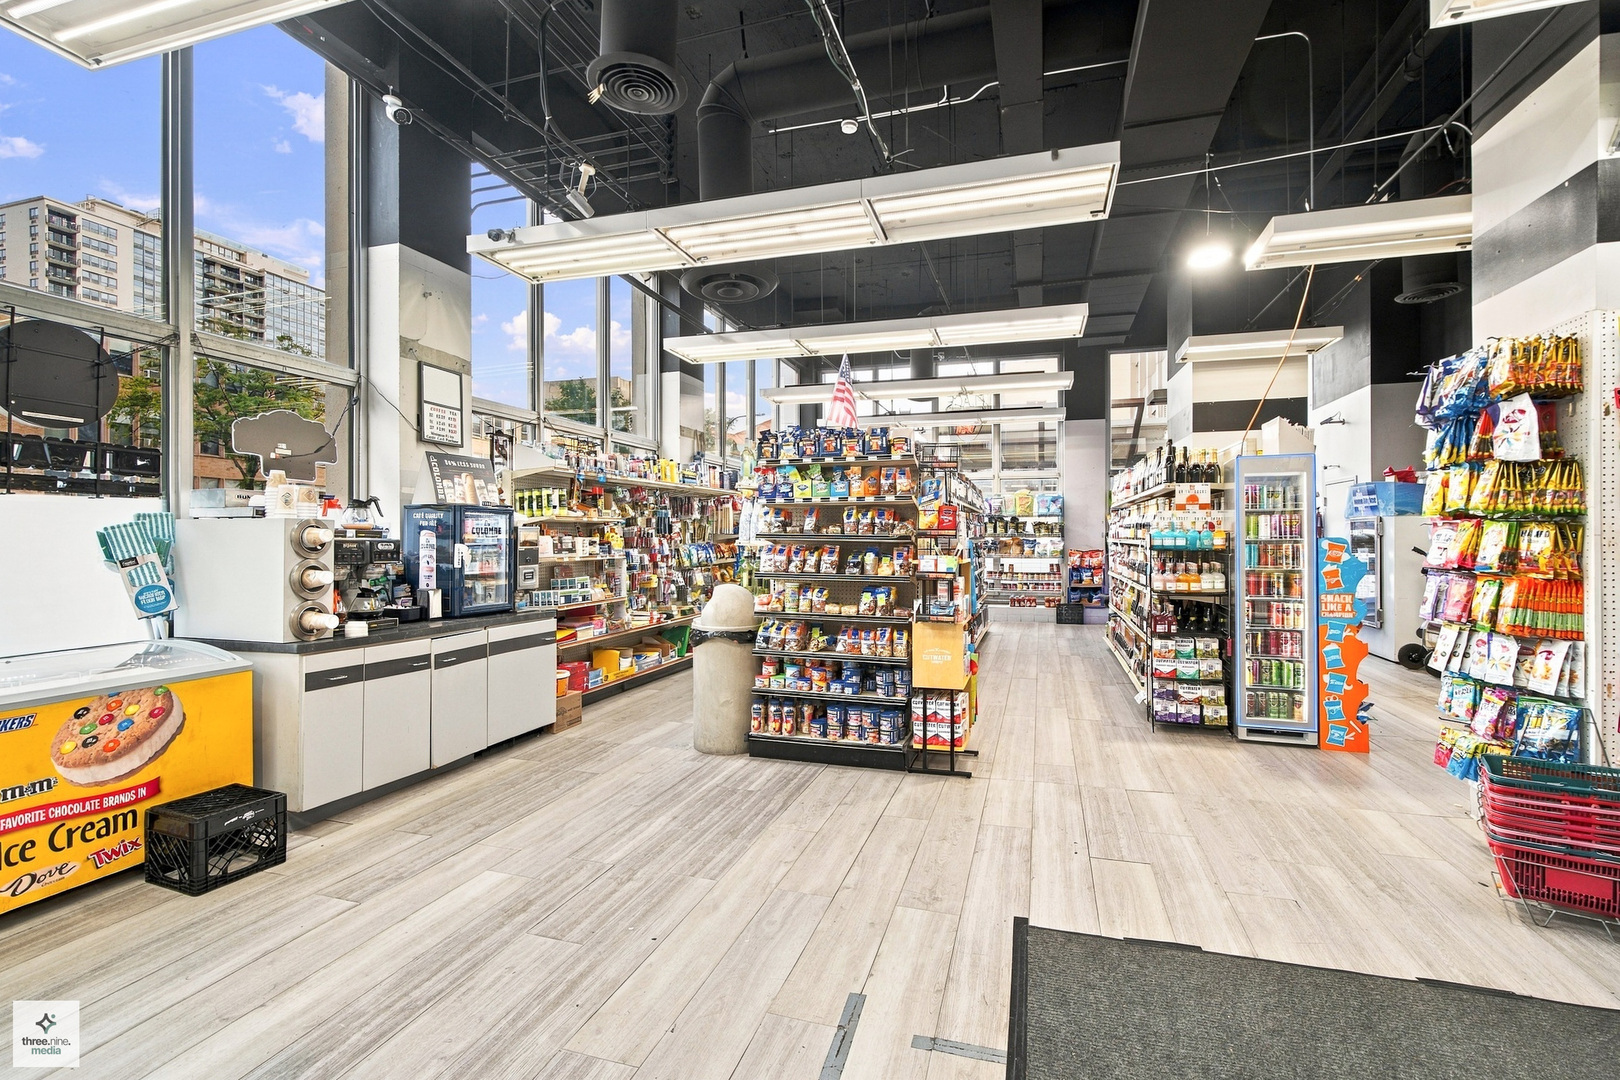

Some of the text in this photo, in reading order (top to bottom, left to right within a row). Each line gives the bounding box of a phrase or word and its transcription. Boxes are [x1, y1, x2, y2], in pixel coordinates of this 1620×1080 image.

[472, 526, 502, 534] COLOMBE
[1320, 594, 1352, 603] SNACK
[1322, 602, 1352, 611] LIKE A
[0, 714, 34, 732] KERS
[0, 787, 146, 831] FAVORITE CHOCOLATE BRANDS IN
[48, 808, 138, 852] Cream
[88, 837, 142, 869] Twix
[0, 861, 76, 897] Dove
